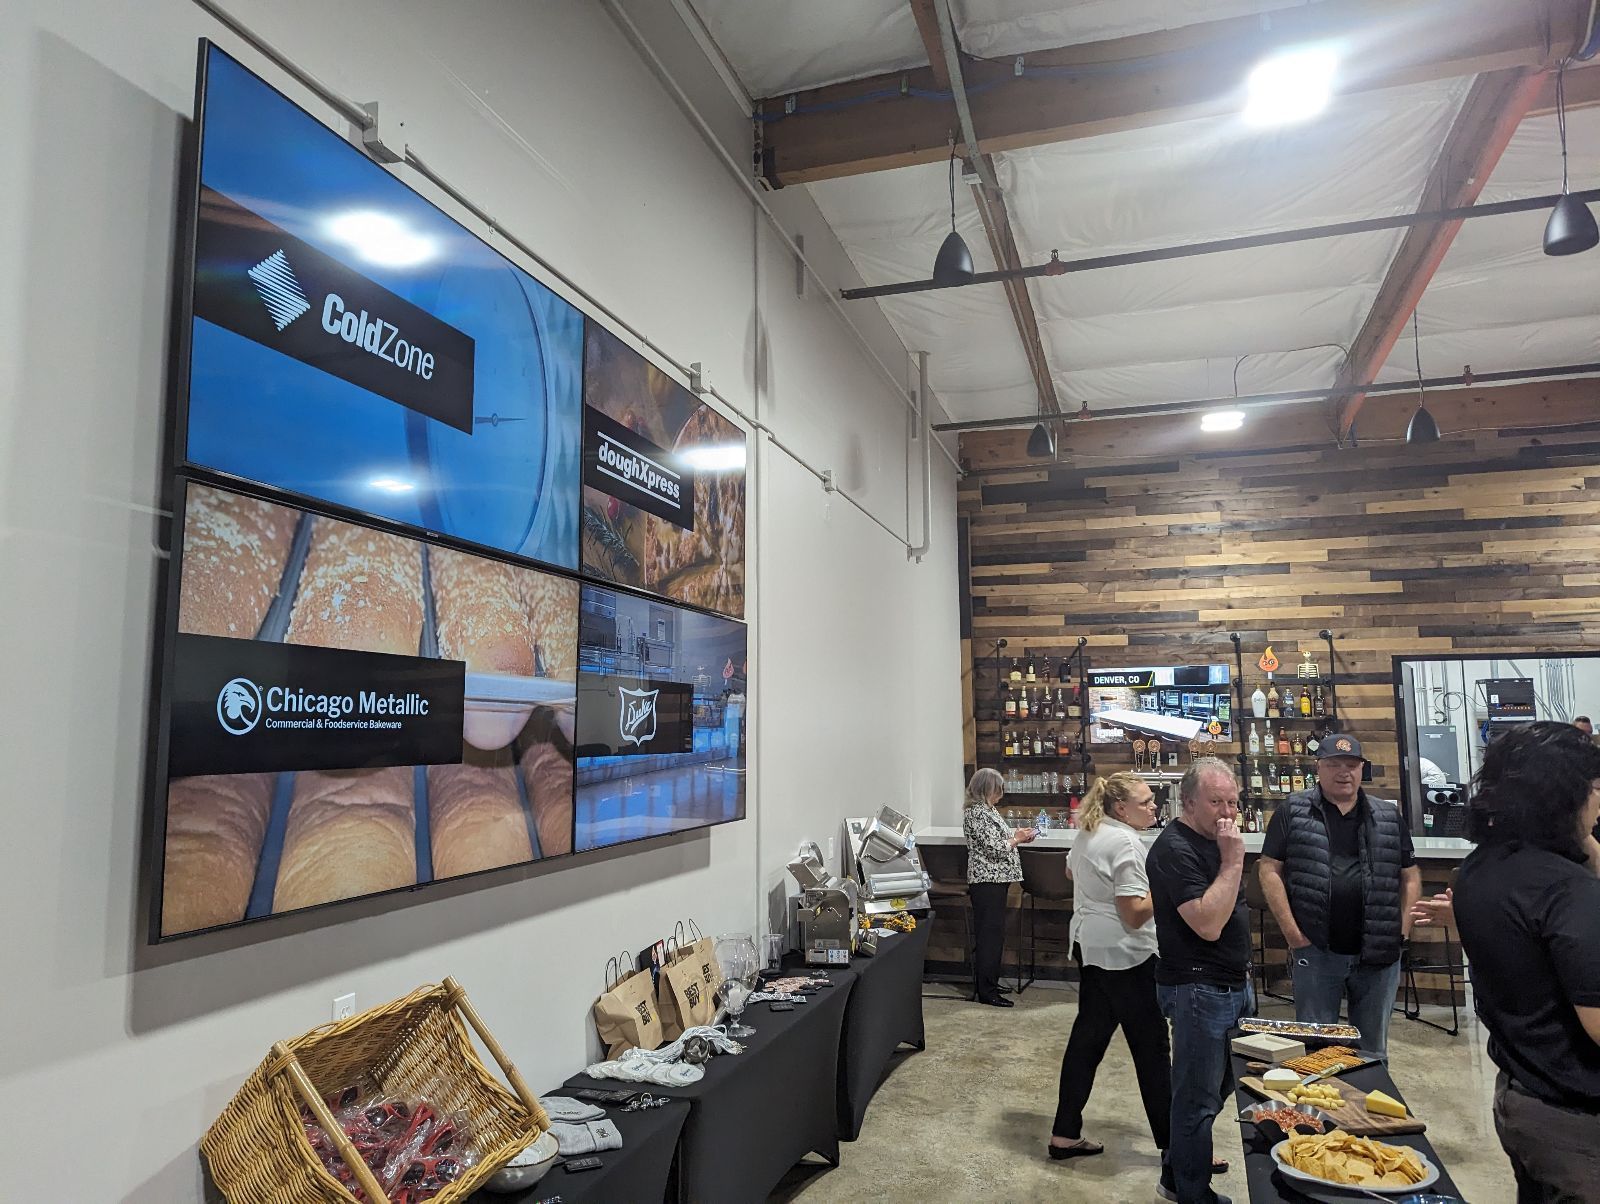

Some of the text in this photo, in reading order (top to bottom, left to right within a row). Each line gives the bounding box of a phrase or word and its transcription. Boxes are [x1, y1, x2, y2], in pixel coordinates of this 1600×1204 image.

[321, 293, 435, 380] ColdZone
[598, 441, 680, 499] doughXpress
[1094, 675, 1140, 685] DENVER, CO
[266, 686, 429, 718] Chicago Metallic
[265, 717, 402, 729] Commercial & Foodservice Bakeware
